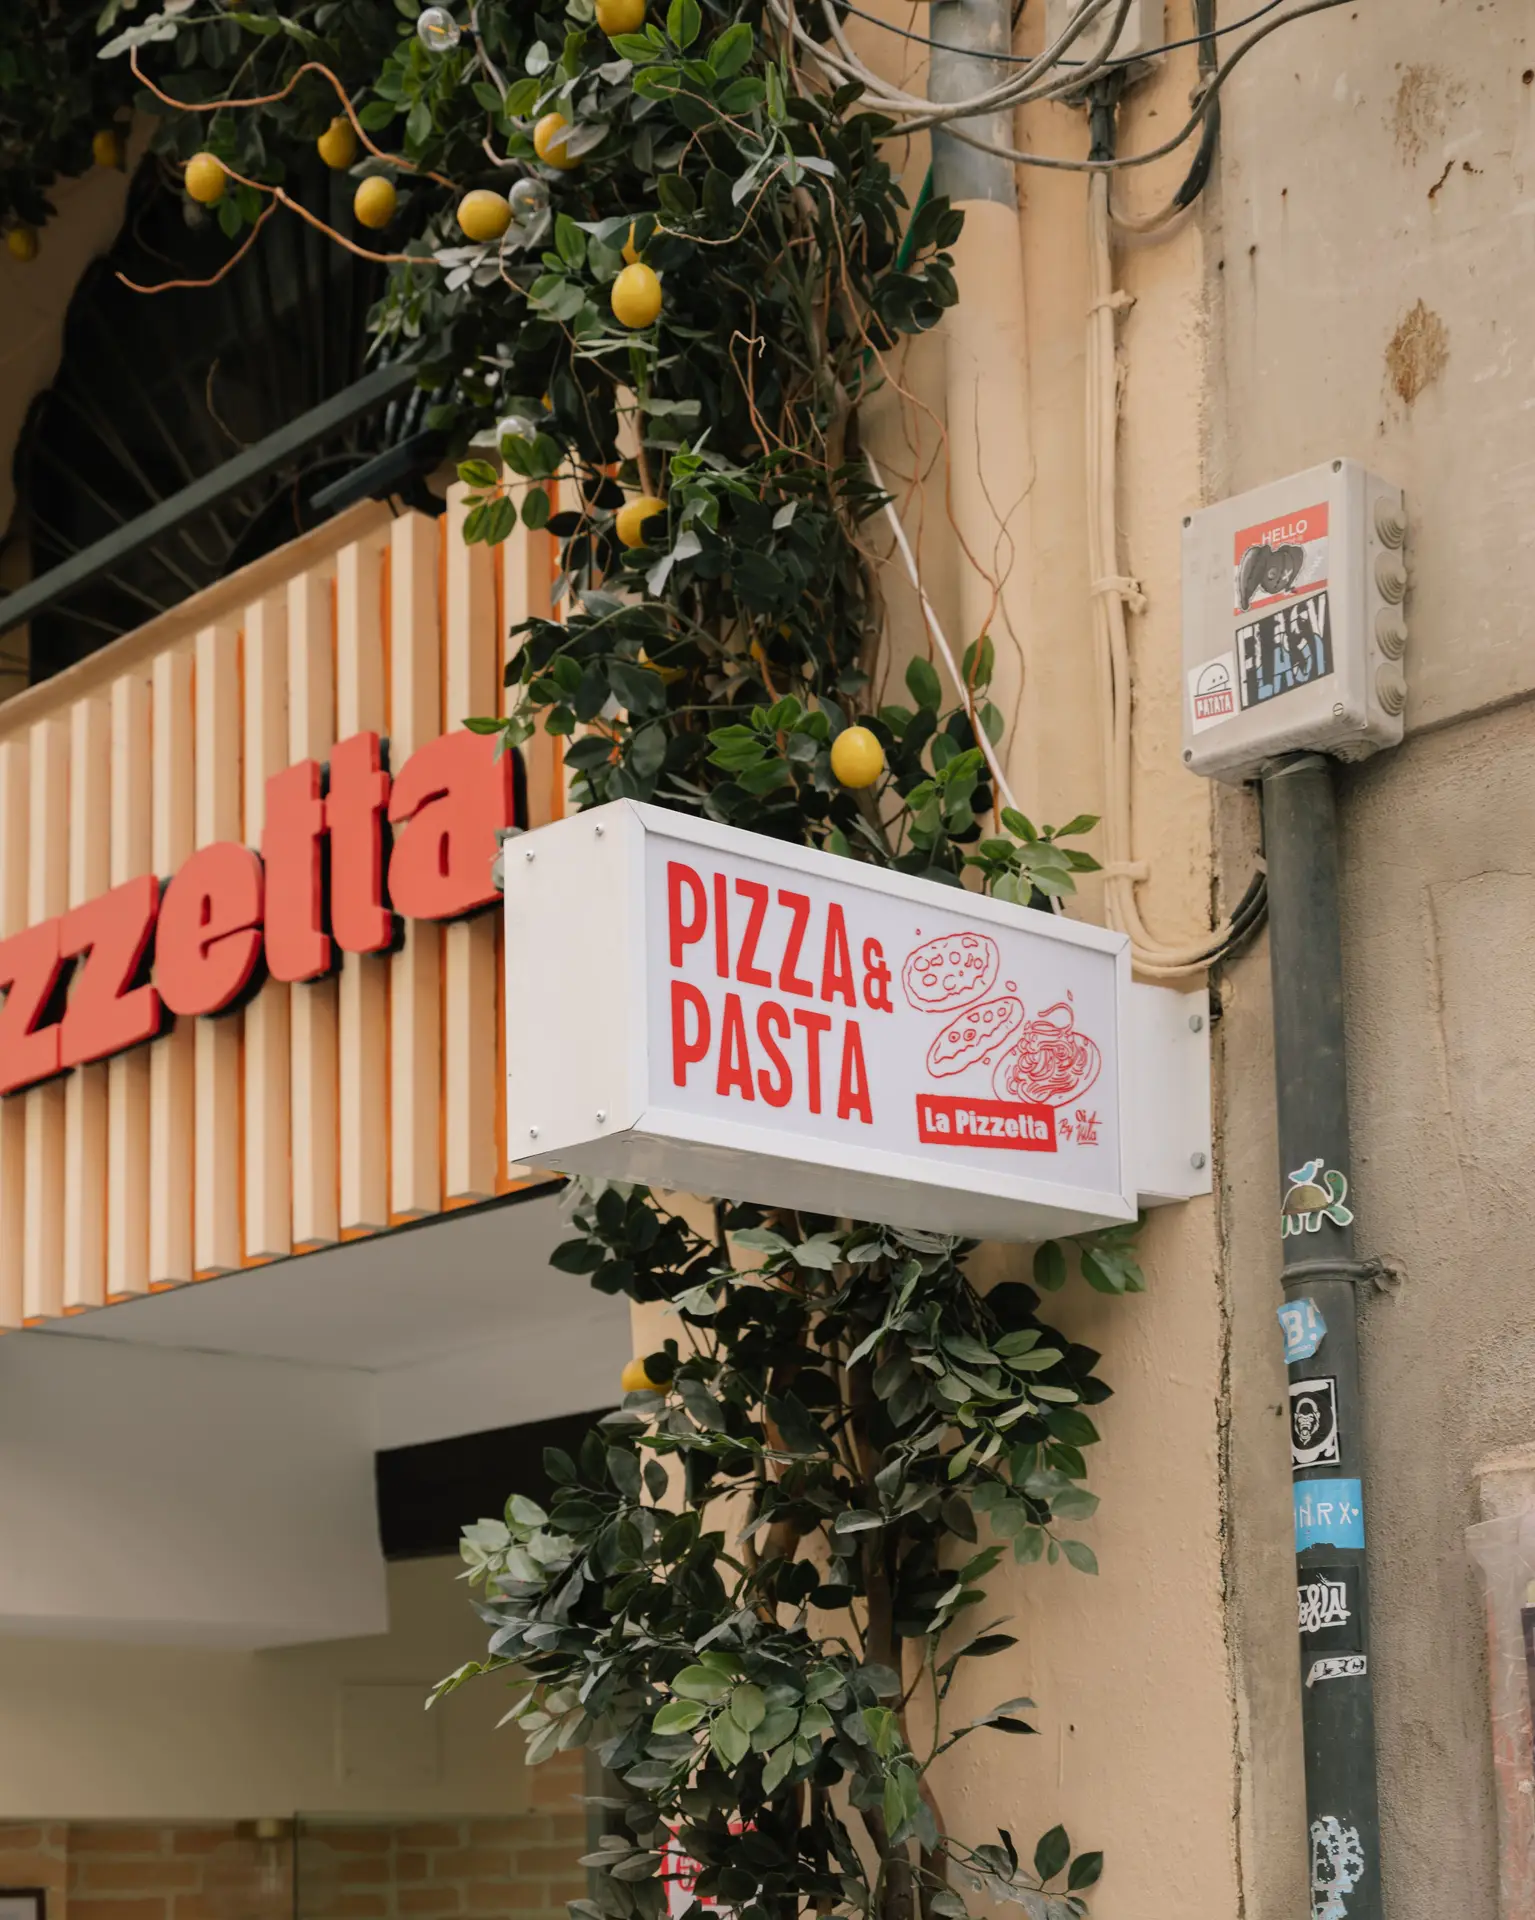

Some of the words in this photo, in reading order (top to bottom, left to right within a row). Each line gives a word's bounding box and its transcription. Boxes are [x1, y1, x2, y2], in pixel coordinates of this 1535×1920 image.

[1262, 519, 1308, 545] HELLO
[667, 860, 857, 1008] PIZZA
[670, 979, 874, 1125] PASTA
[924, 1106, 951, 1134] La
[955, 1109, 1049, 1141] Pizzetta
[1058, 1118, 1074, 1141] By
